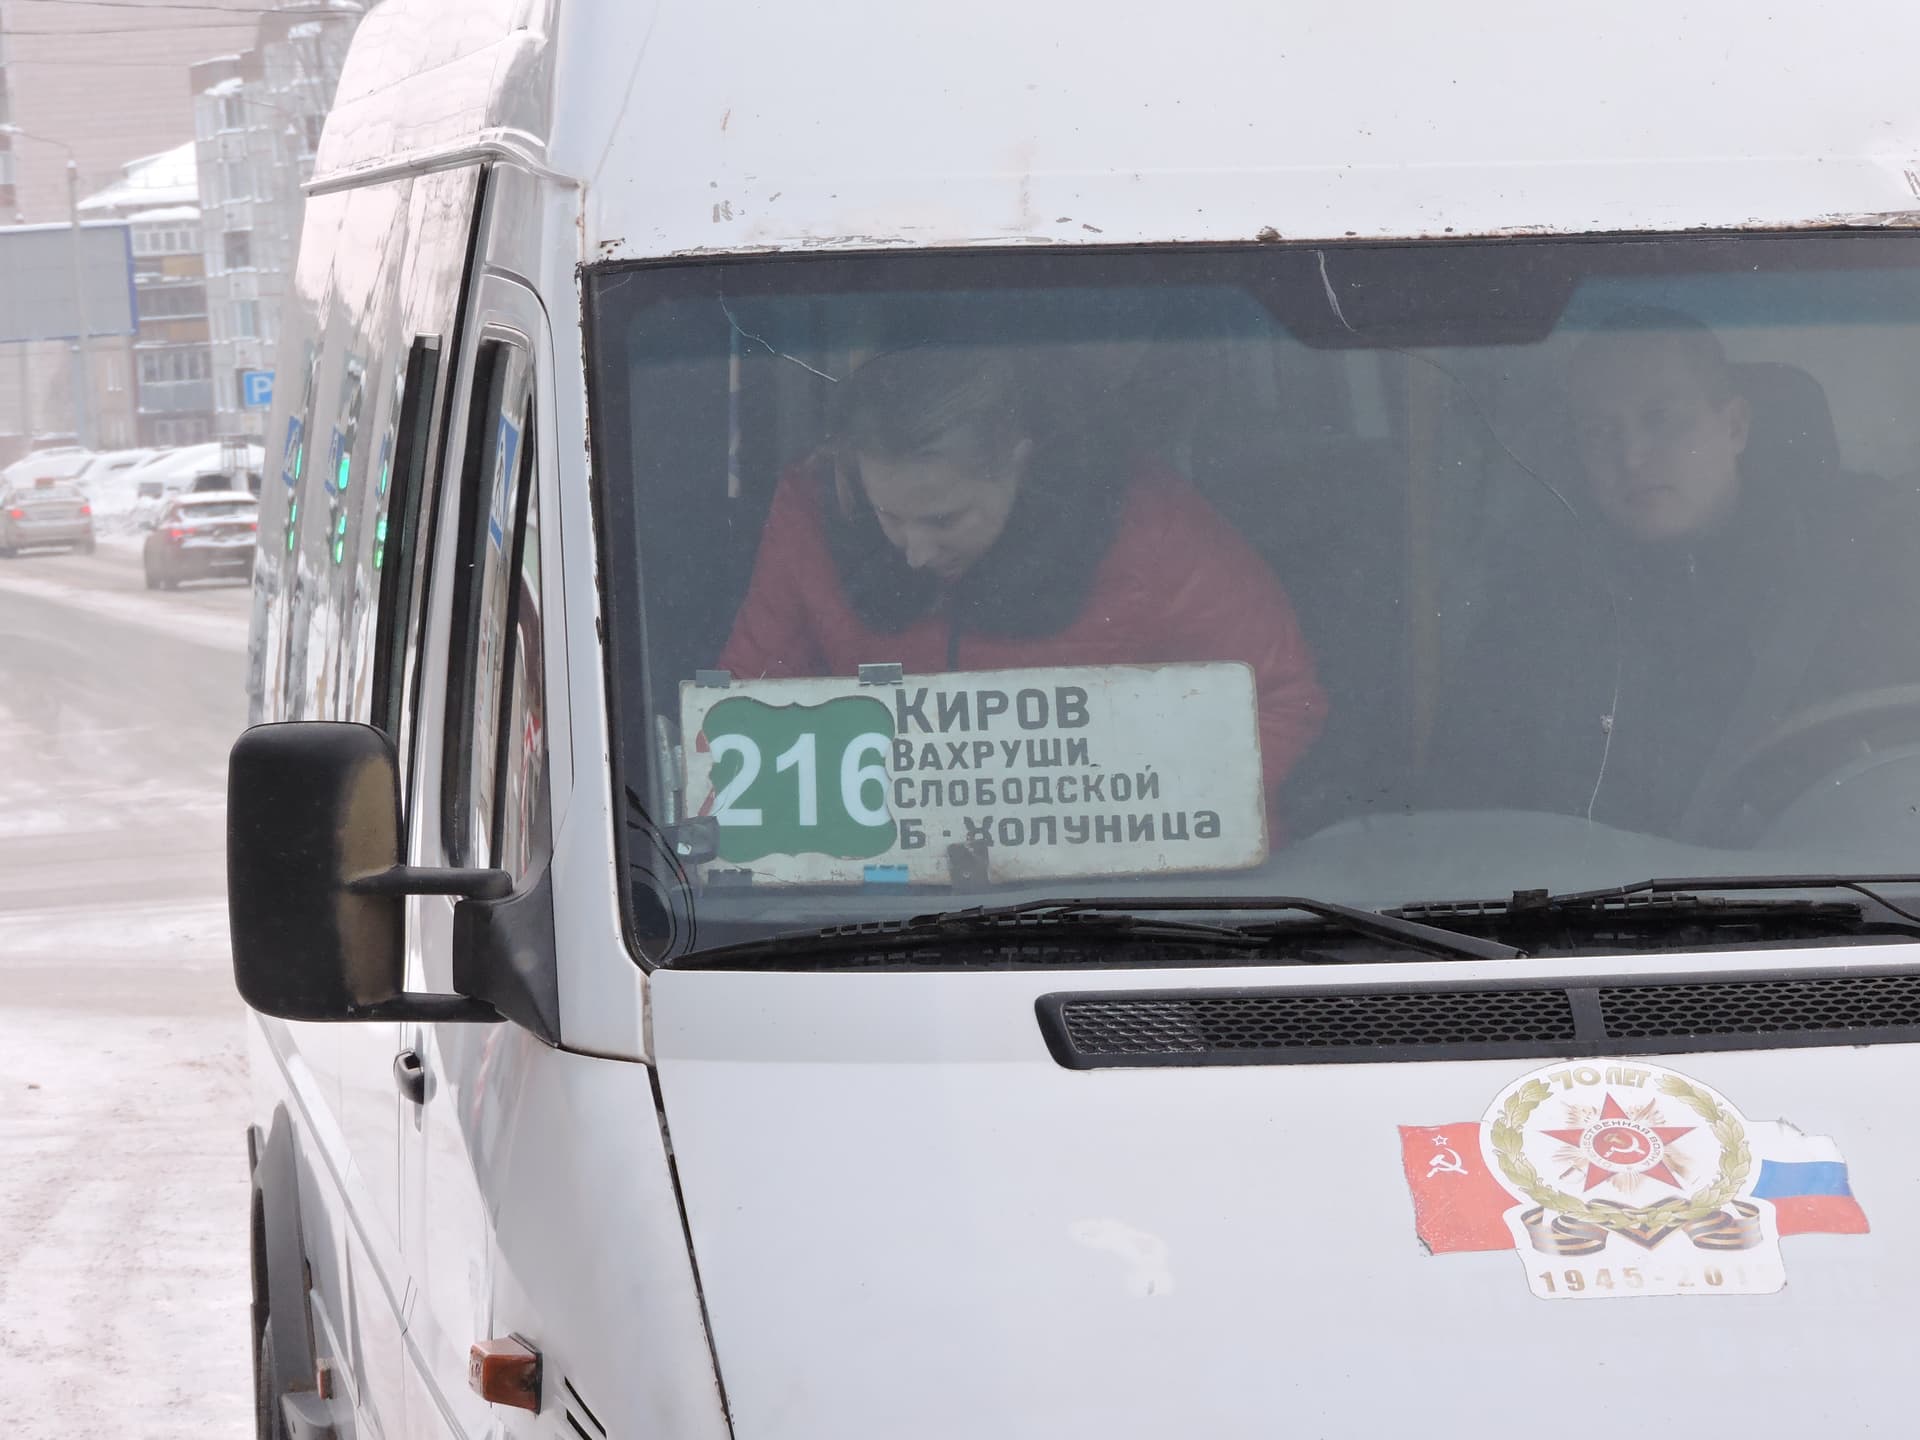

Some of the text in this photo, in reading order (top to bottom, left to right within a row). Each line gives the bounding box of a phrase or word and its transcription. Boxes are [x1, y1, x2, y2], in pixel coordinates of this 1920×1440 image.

[895, 686, 1090, 734] КИРОВ
[892, 737, 1090, 772] ВАХРУШИ
[709, 732, 892, 827] 216
[893, 764, 1160, 809] СЛОБОДСКОЙ
[1548, 1066, 1651, 1090] 70 ЛЕТ
